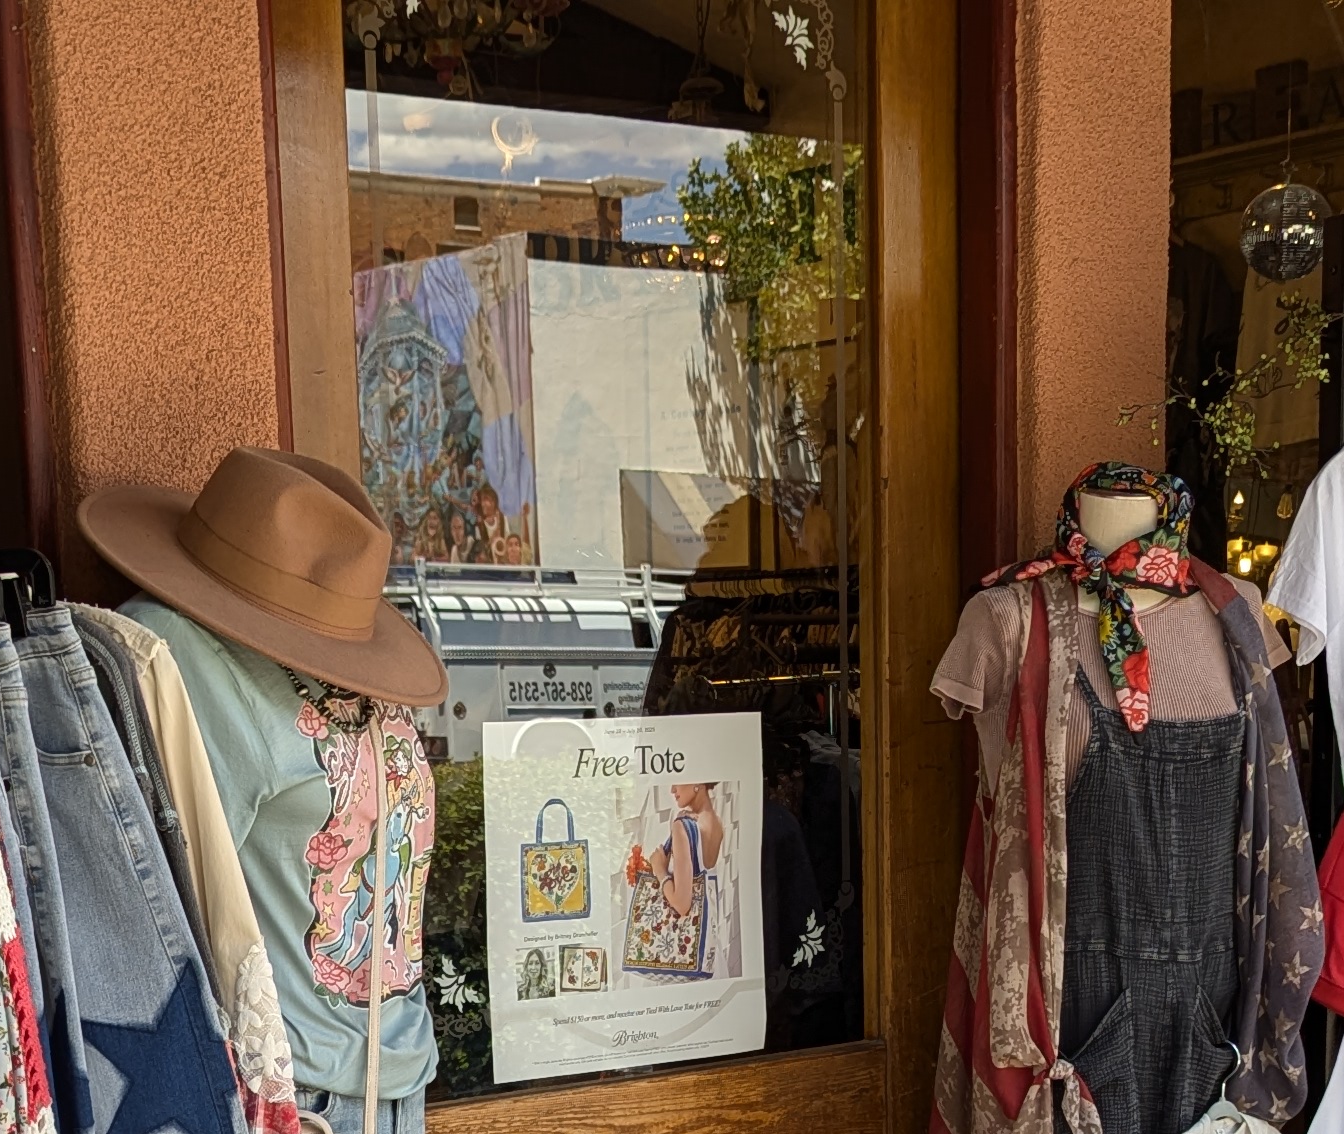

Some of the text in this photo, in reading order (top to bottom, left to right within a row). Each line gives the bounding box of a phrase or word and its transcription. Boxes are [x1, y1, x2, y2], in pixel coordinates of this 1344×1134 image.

[572, 744, 686, 779] Free Tote
[523, 935, 547, 943] Designed
[552, 1017, 570, 1027] Spend
[606, 1011, 617, 1020] and
[617, 1010, 635, 1019] receive
[635, 1009, 645, 1017] our
[645, 1006, 657, 1016] Tied
[657, 1005, 670, 1014] With
[670, 1003, 684, 1013] Love
[684, 1002, 695, 1011] Tote
[611, 1029, 658, 1048] Brighton
